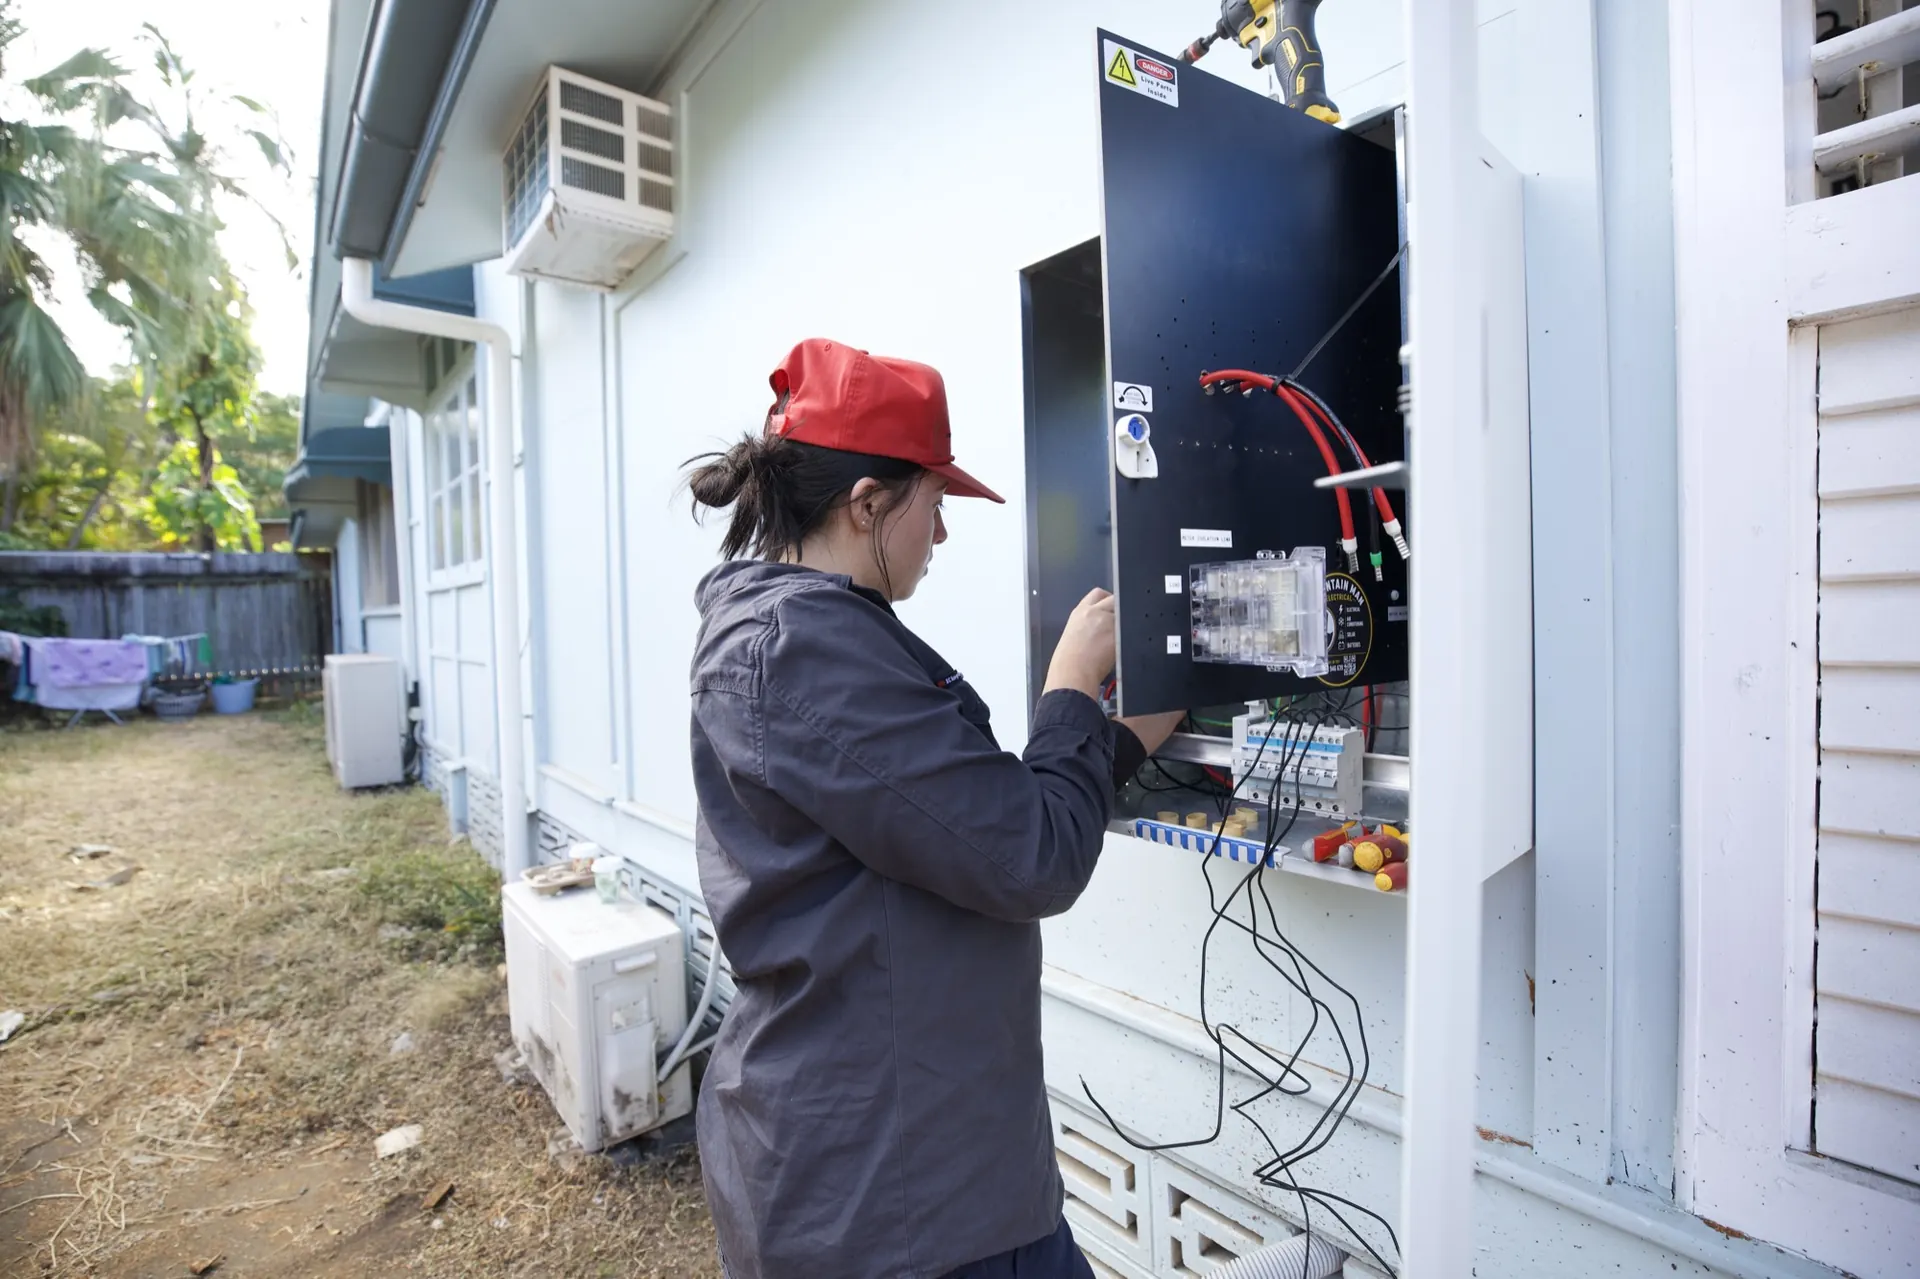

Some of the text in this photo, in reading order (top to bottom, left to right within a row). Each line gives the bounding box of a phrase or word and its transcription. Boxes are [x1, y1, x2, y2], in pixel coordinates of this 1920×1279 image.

[1142, 61, 1168, 77] DANGER
[1140, 76, 1172, 92] Live Parts
[1147, 87, 1166, 99] Inside
[1325, 578, 1365, 606] NTAIN MAN
[1327, 593, 1353, 601] LECTRICAL
